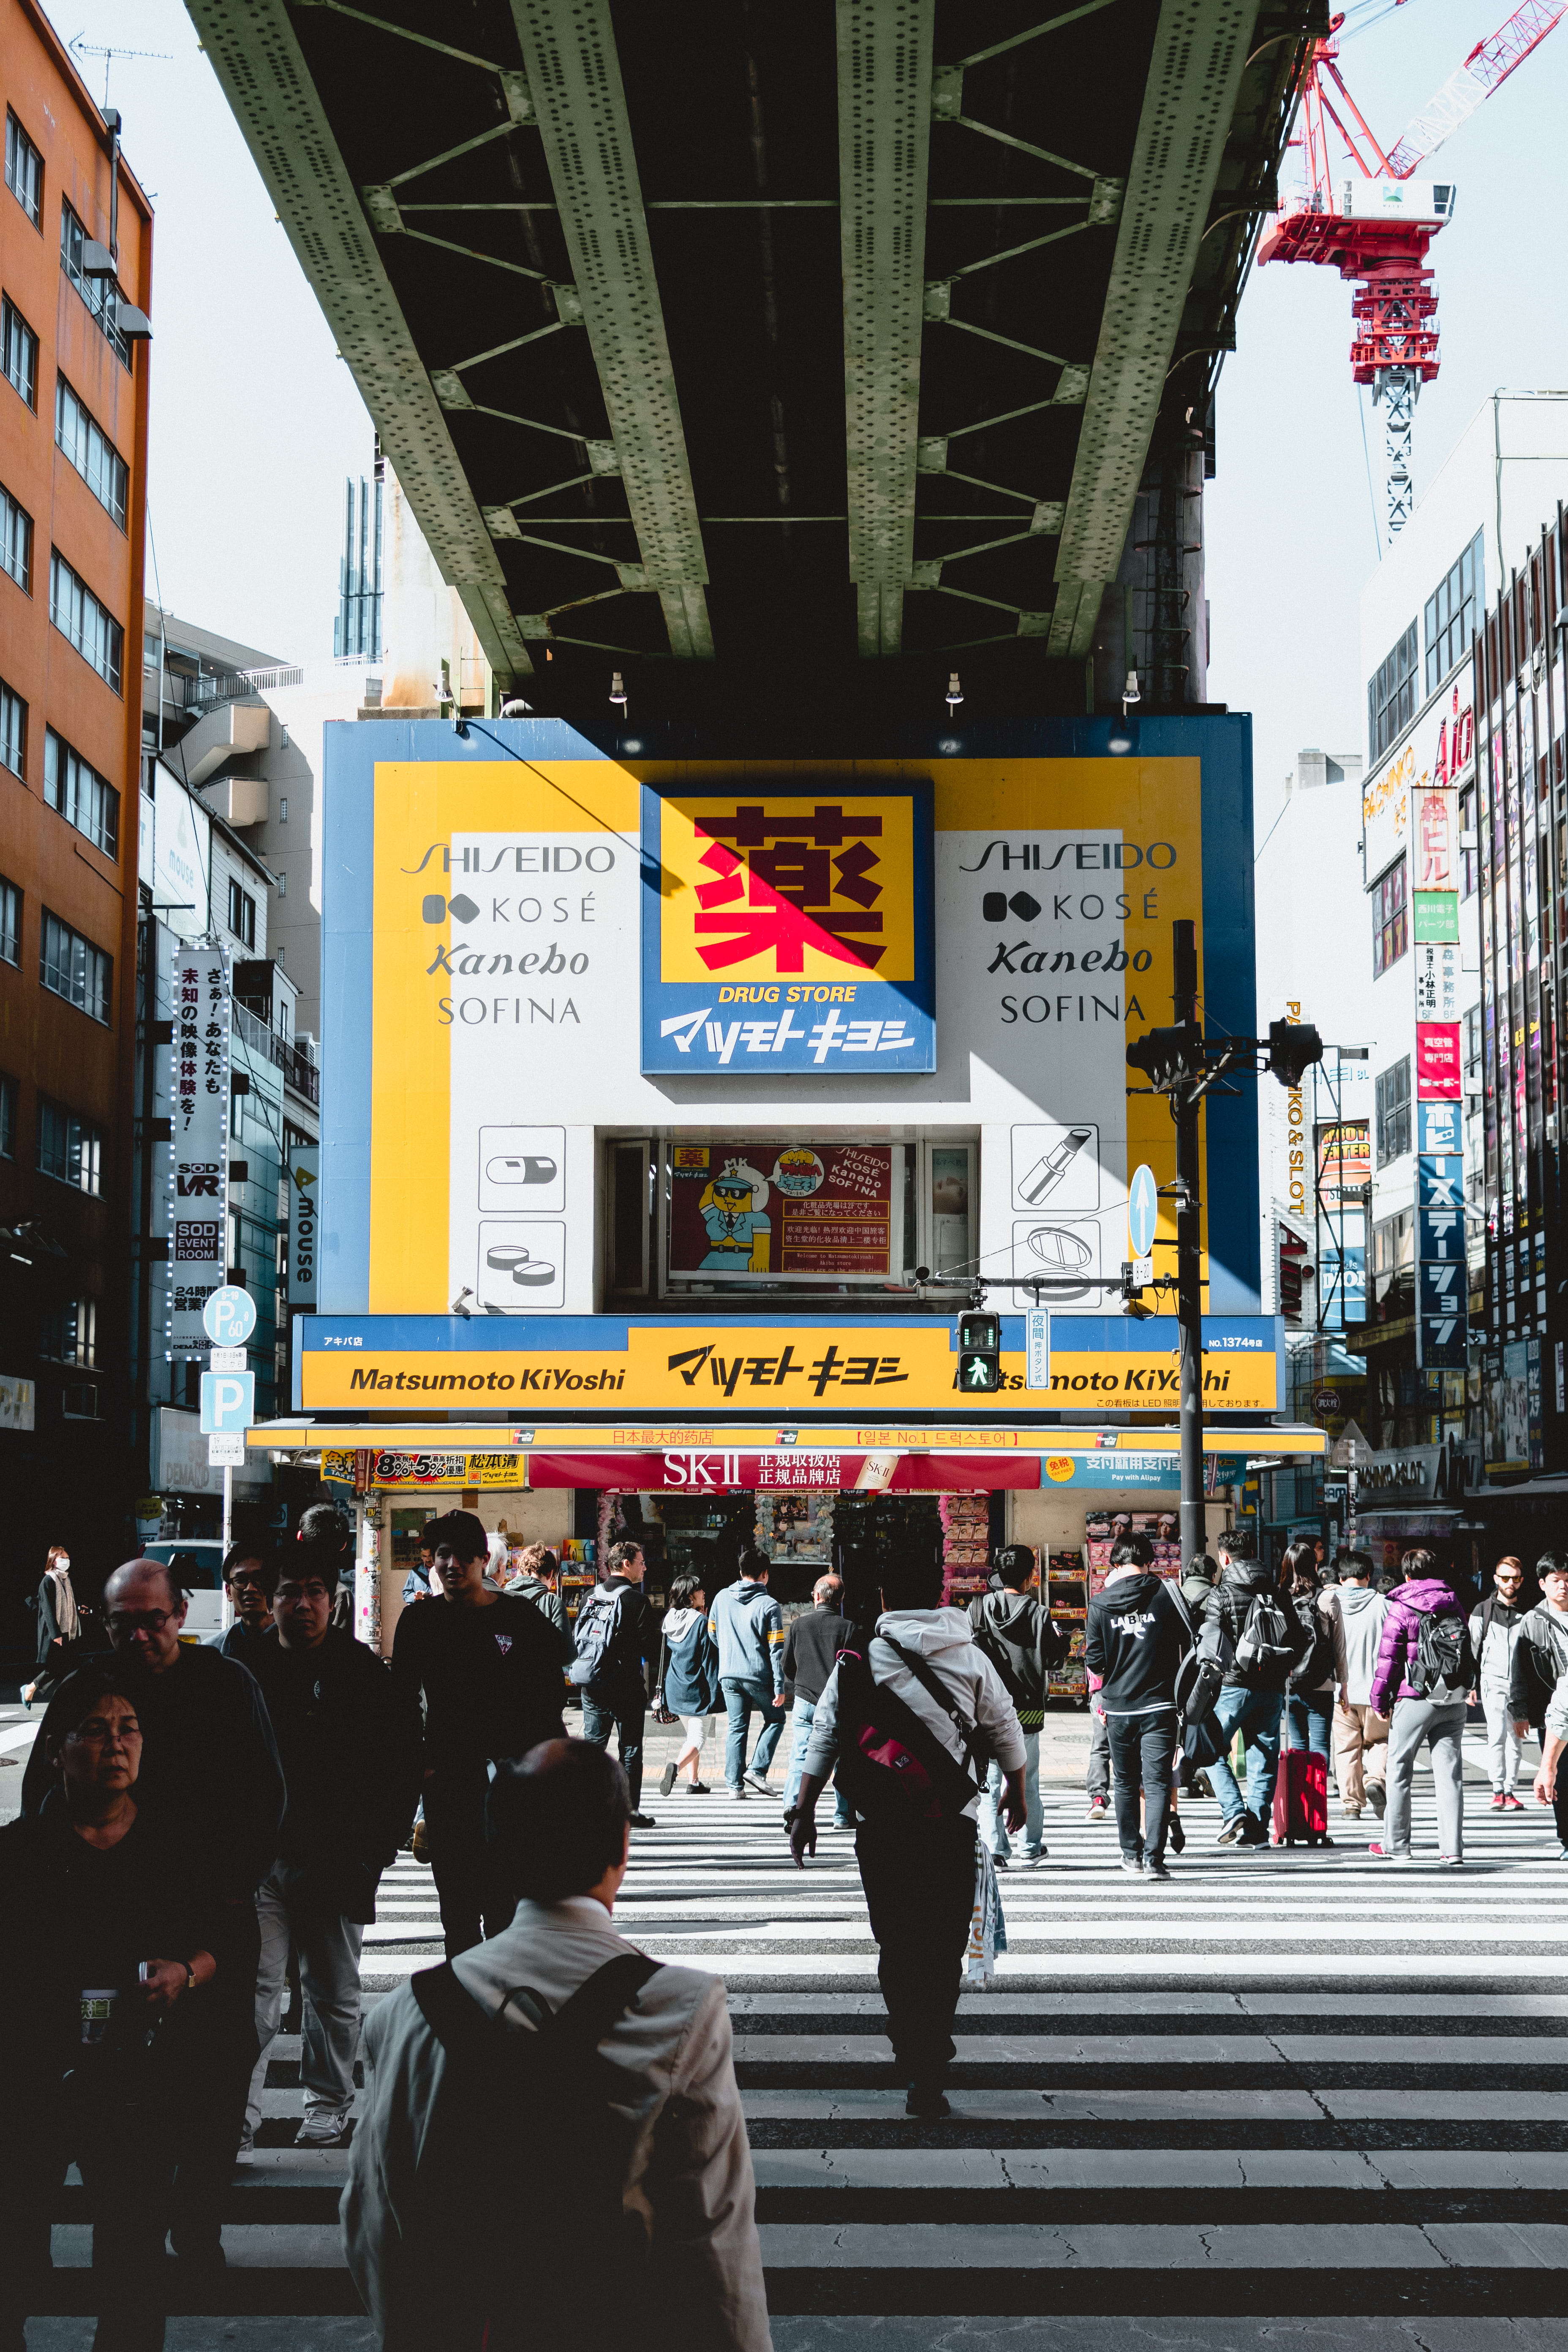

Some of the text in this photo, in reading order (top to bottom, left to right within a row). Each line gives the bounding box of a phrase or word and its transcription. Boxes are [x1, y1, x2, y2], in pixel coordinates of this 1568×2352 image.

[400, 843, 615, 874] SHISEIDO
[959, 841, 1176, 871] SHISEIDO
[169, 849, 194, 889] mouse
[694, 806, 887, 972] 薬
[493, 891, 595, 923] KOSÉ
[1054, 888, 1158, 920] KOSÉ
[1418, 904, 1454, 914] 西川電子
[1418, 920, 1454, 928] パーツ部
[426, 942, 589, 975] Kanebo
[987, 939, 1152, 974] Kanebo
[718, 986, 857, 1002] DRUG STORE
[438, 997, 580, 1024] SOFINA
[1001, 995, 1145, 1023] SOFINA
[1424, 1037, 1453, 1047] 真空管
[1425, 1053, 1453, 1063] 専門店
[679, 1149, 703, 1166] 薬
[836, 1148, 889, 1170] SHISEIDO
[1322, 1143, 1370, 1162] CENTER
[178, 1163, 220, 1174] SOD
[831, 1165, 882, 1188] Kanebo
[843, 1159, 880, 1177] KOSÉ
[177, 1175, 220, 1196] VR
[1289, 1150, 1304, 1215] SLOT
[178, 1223, 216, 1236] SOD
[178, 1239, 216, 1248] EVENT
[297, 1197, 314, 1283] mouse
[178, 1250, 214, 1259] ROOM
[215, 1301, 236, 1337] P
[1032, 1315, 1044, 1340] 夜間
[228, 1321, 243, 1337] 60
[324, 1336, 363, 1347] アキバ店
[1034, 1342, 1042, 1383] 押ボタン式
[350, 1369, 626, 1391] Matsumoto KiYoshi
[215, 1379, 244, 1427] P
[1097, 1399, 1140, 1408] この看板は
[1318, 1398, 1338, 1408] 消火栓
[613, 1430, 713, 1445] 日本最大的药店
[898, 1432, 927, 1444] No.1
[934, 1431, 1006, 1446] 드럭스토어
[468, 1454, 518, 1468] 松本清
[664, 1454, 742, 1485] SK-II
[1049, 1458, 1069, 1470] 免税
[332, 1469, 345, 1478] TAX
[758, 1469, 841, 1485] 正规品牌店
